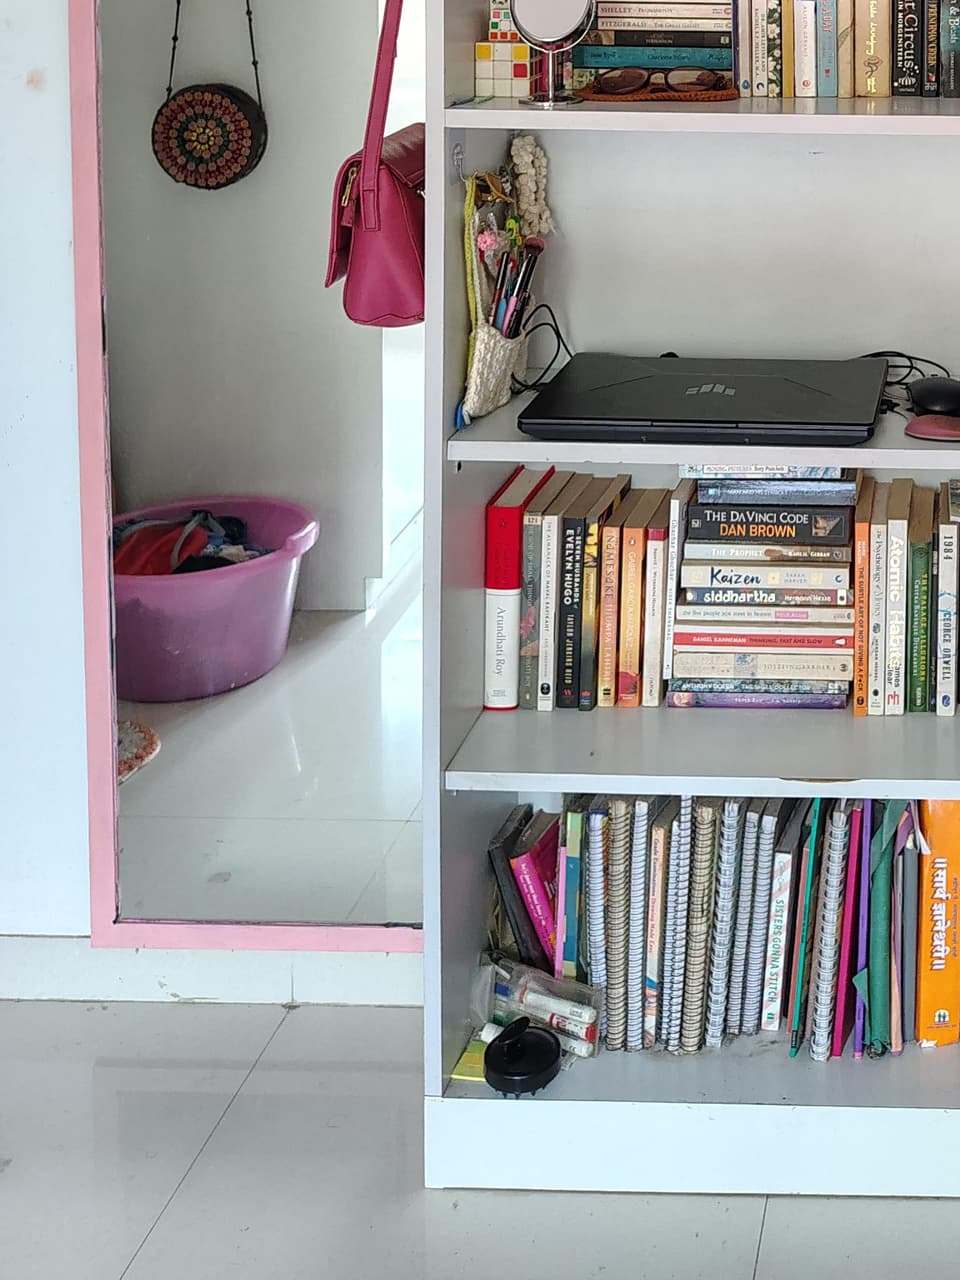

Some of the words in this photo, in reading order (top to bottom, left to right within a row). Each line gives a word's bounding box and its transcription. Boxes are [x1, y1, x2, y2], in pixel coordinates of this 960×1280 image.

[904, 15, 919, 68] Circus
[704, 510, 726, 521] THE
[780, 512, 808, 523] CODE
[720, 524, 746, 536] DAN
[750, 524, 796, 537] BROWN
[565, 530, 574, 575] EVELYN
[943, 536, 953, 561] 1984
[711, 567, 761, 586] Kaizen
[890, 536, 904, 602] Atomic
[564, 576, 572, 605] HUGO
[704, 591, 775, 603] siddhartha
[496, 608, 507, 657] Arundhati
[495, 657, 505, 676] Roy
[774, 899, 785, 935] SISTERS
[771, 936, 782, 972] GONNA
[767, 972, 779, 1010] STITCH
